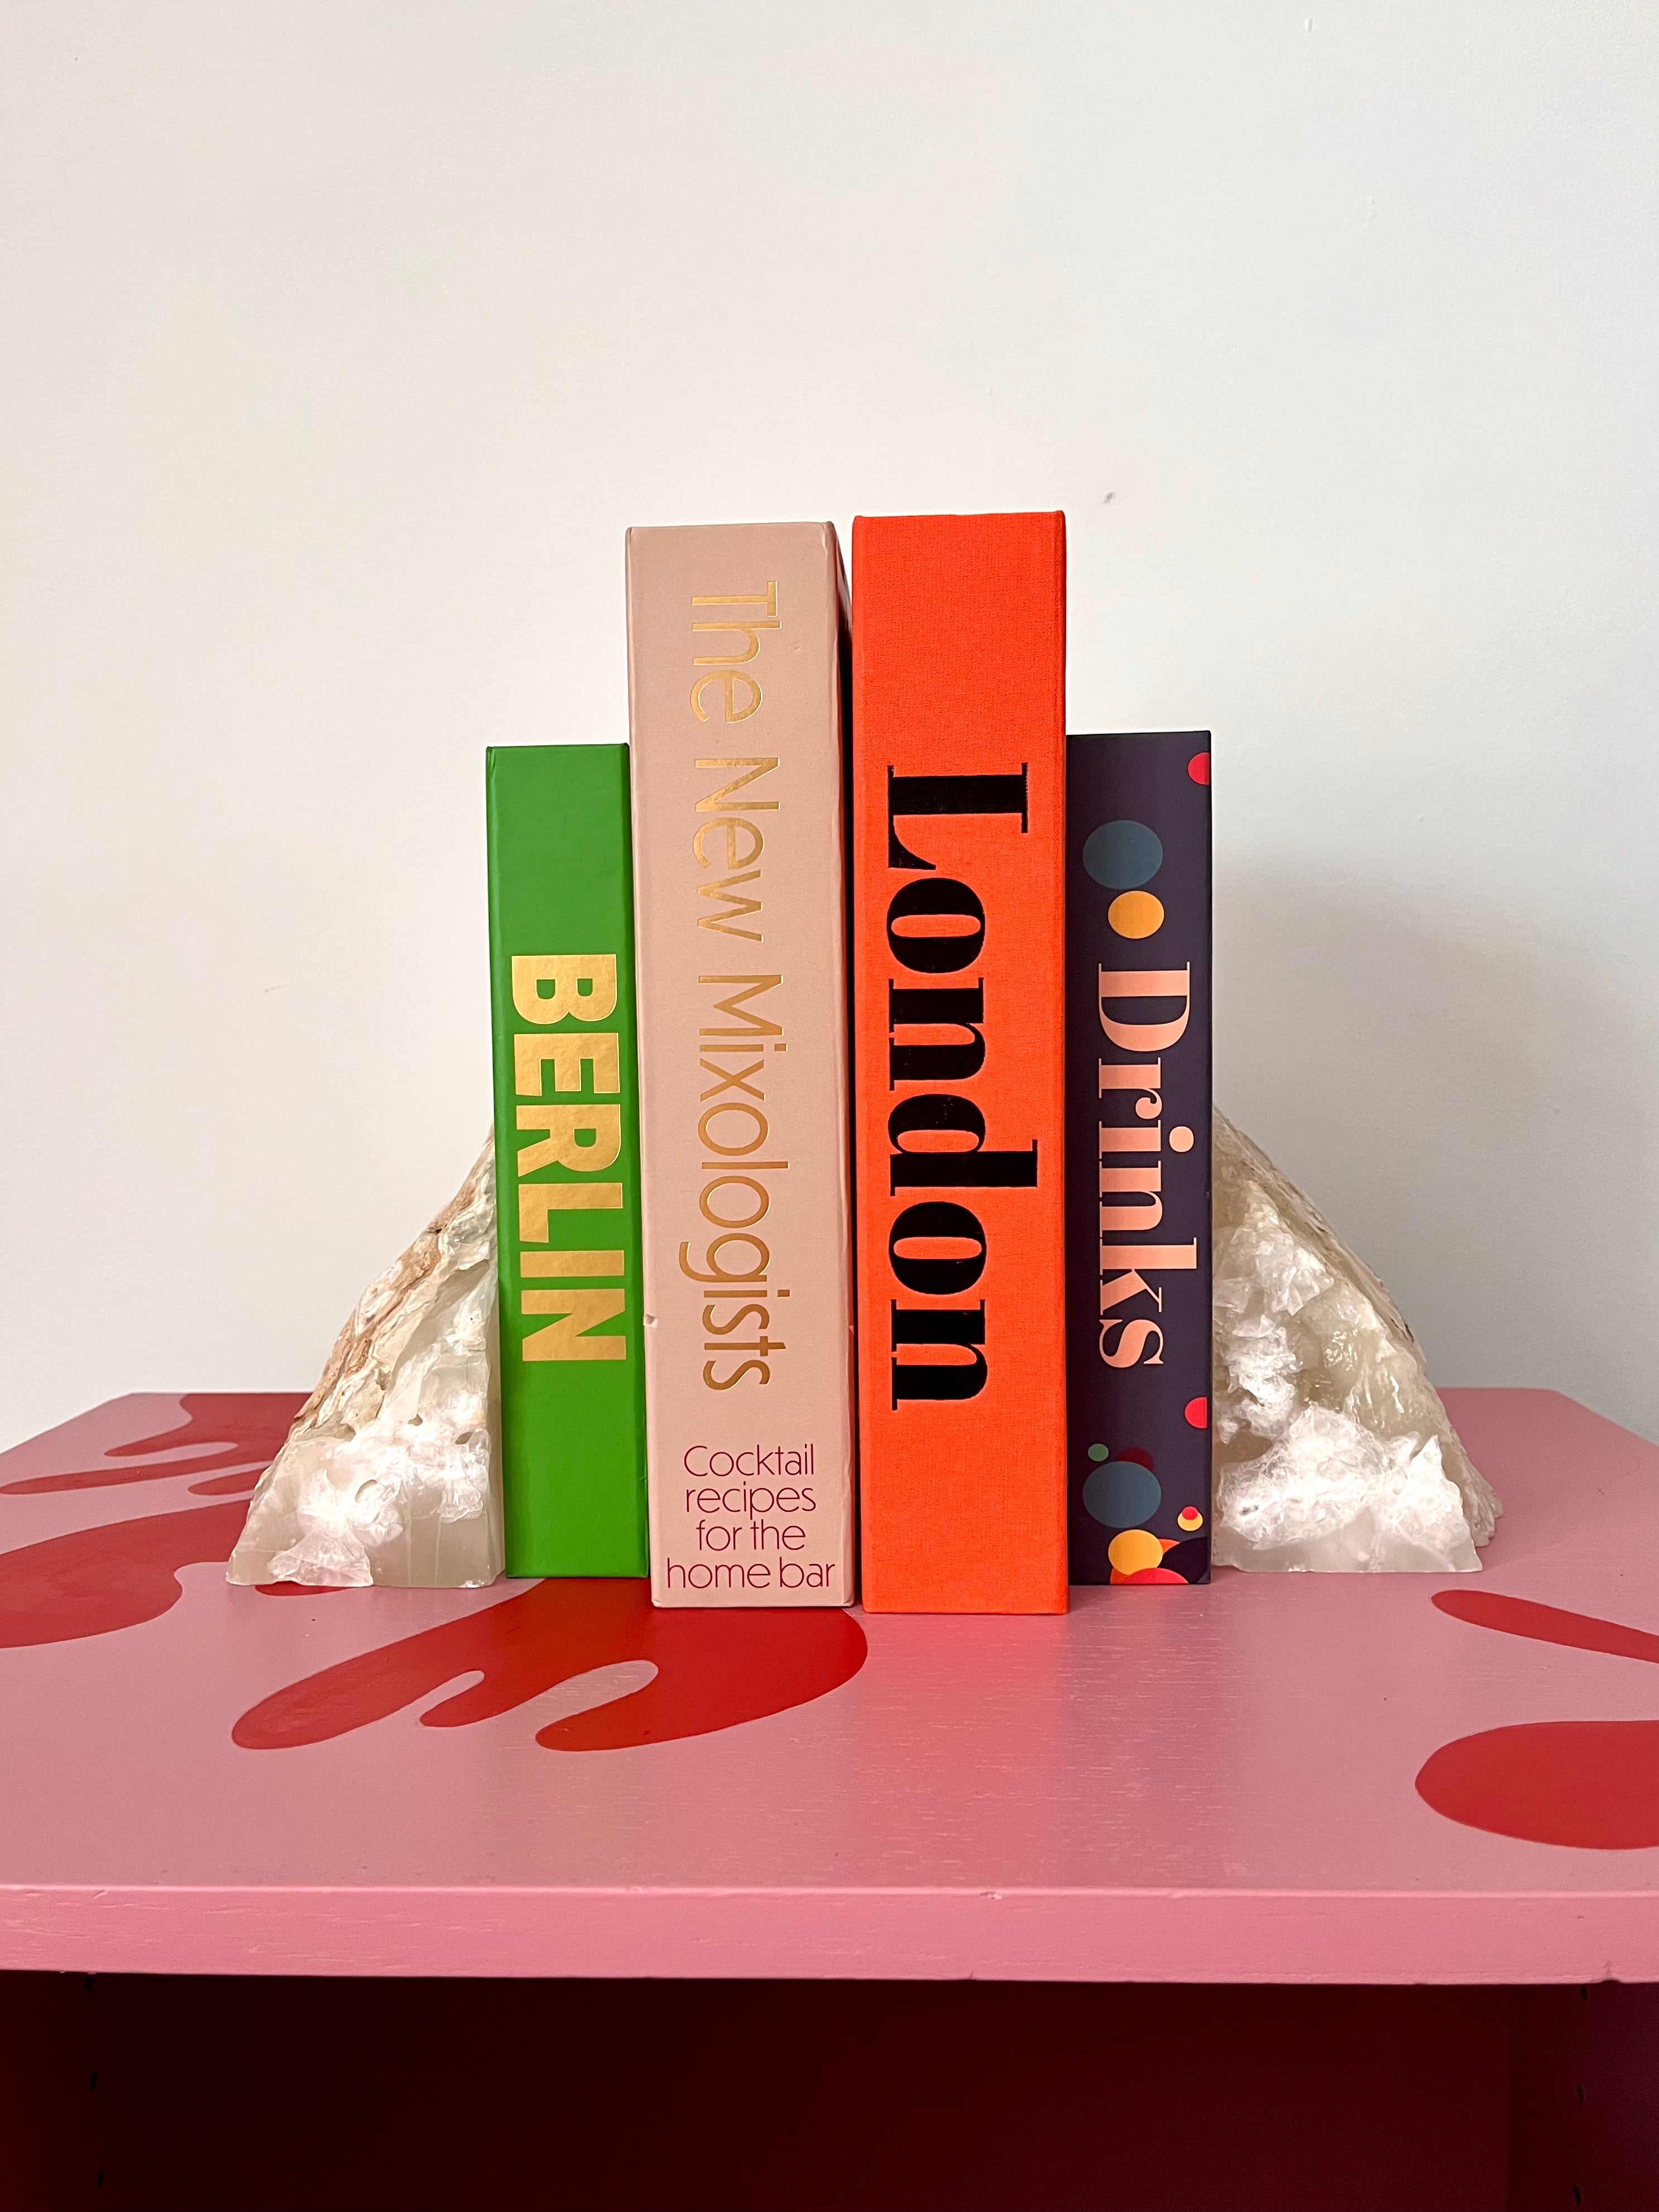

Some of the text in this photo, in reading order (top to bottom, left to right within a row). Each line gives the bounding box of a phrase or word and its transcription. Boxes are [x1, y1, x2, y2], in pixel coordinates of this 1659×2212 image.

[680, 580, 790, 1390] The New Mixologists
[886, 763, 1038, 1410] London
[511, 954, 626, 1362] BERLIN
[1097, 961, 1198, 1369] Drinks
[684, 1443, 814, 1476] Cocktail
[686, 1481, 817, 1520] recipes
[696, 1519, 806, 1551] for the
[667, 1556, 836, 1589] home bar
